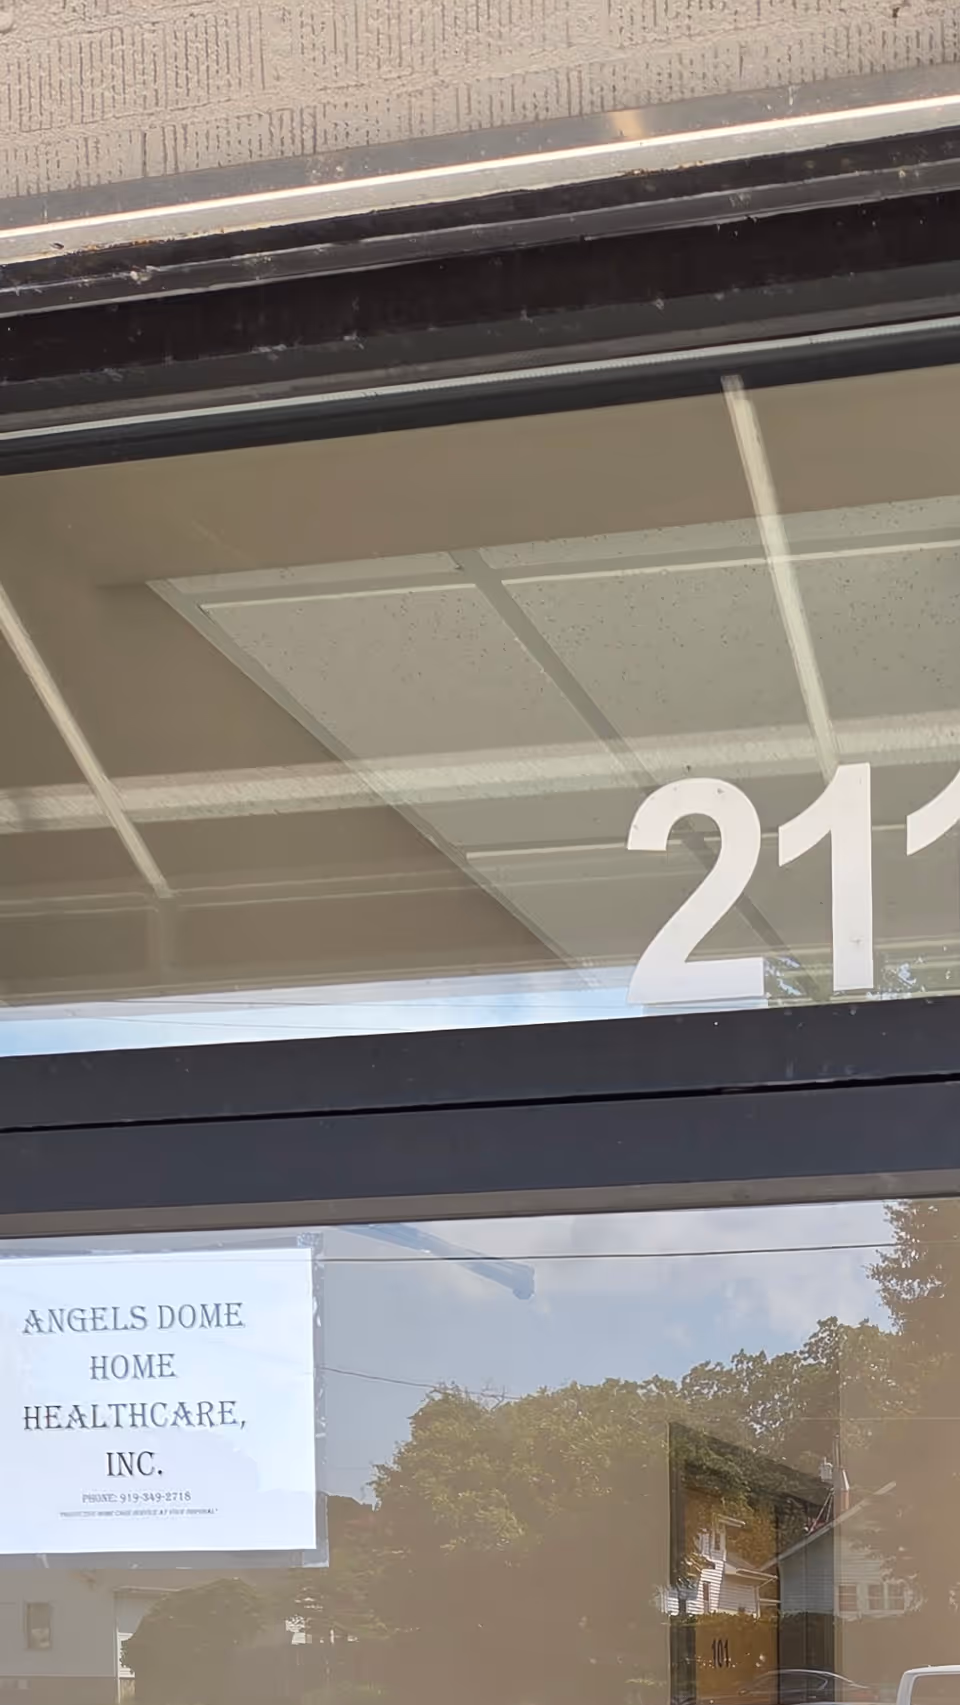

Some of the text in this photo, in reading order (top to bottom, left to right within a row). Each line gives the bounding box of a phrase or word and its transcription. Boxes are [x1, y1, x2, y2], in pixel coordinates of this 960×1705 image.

[22, 1302, 246, 1334] ANGELS DOME
[89, 1353, 177, 1380] HOME
[23, 1401, 246, 1430] HEALTHCARE,
[106, 1451, 163, 1477] INC.
[712, 1638, 729, 1668] 101
